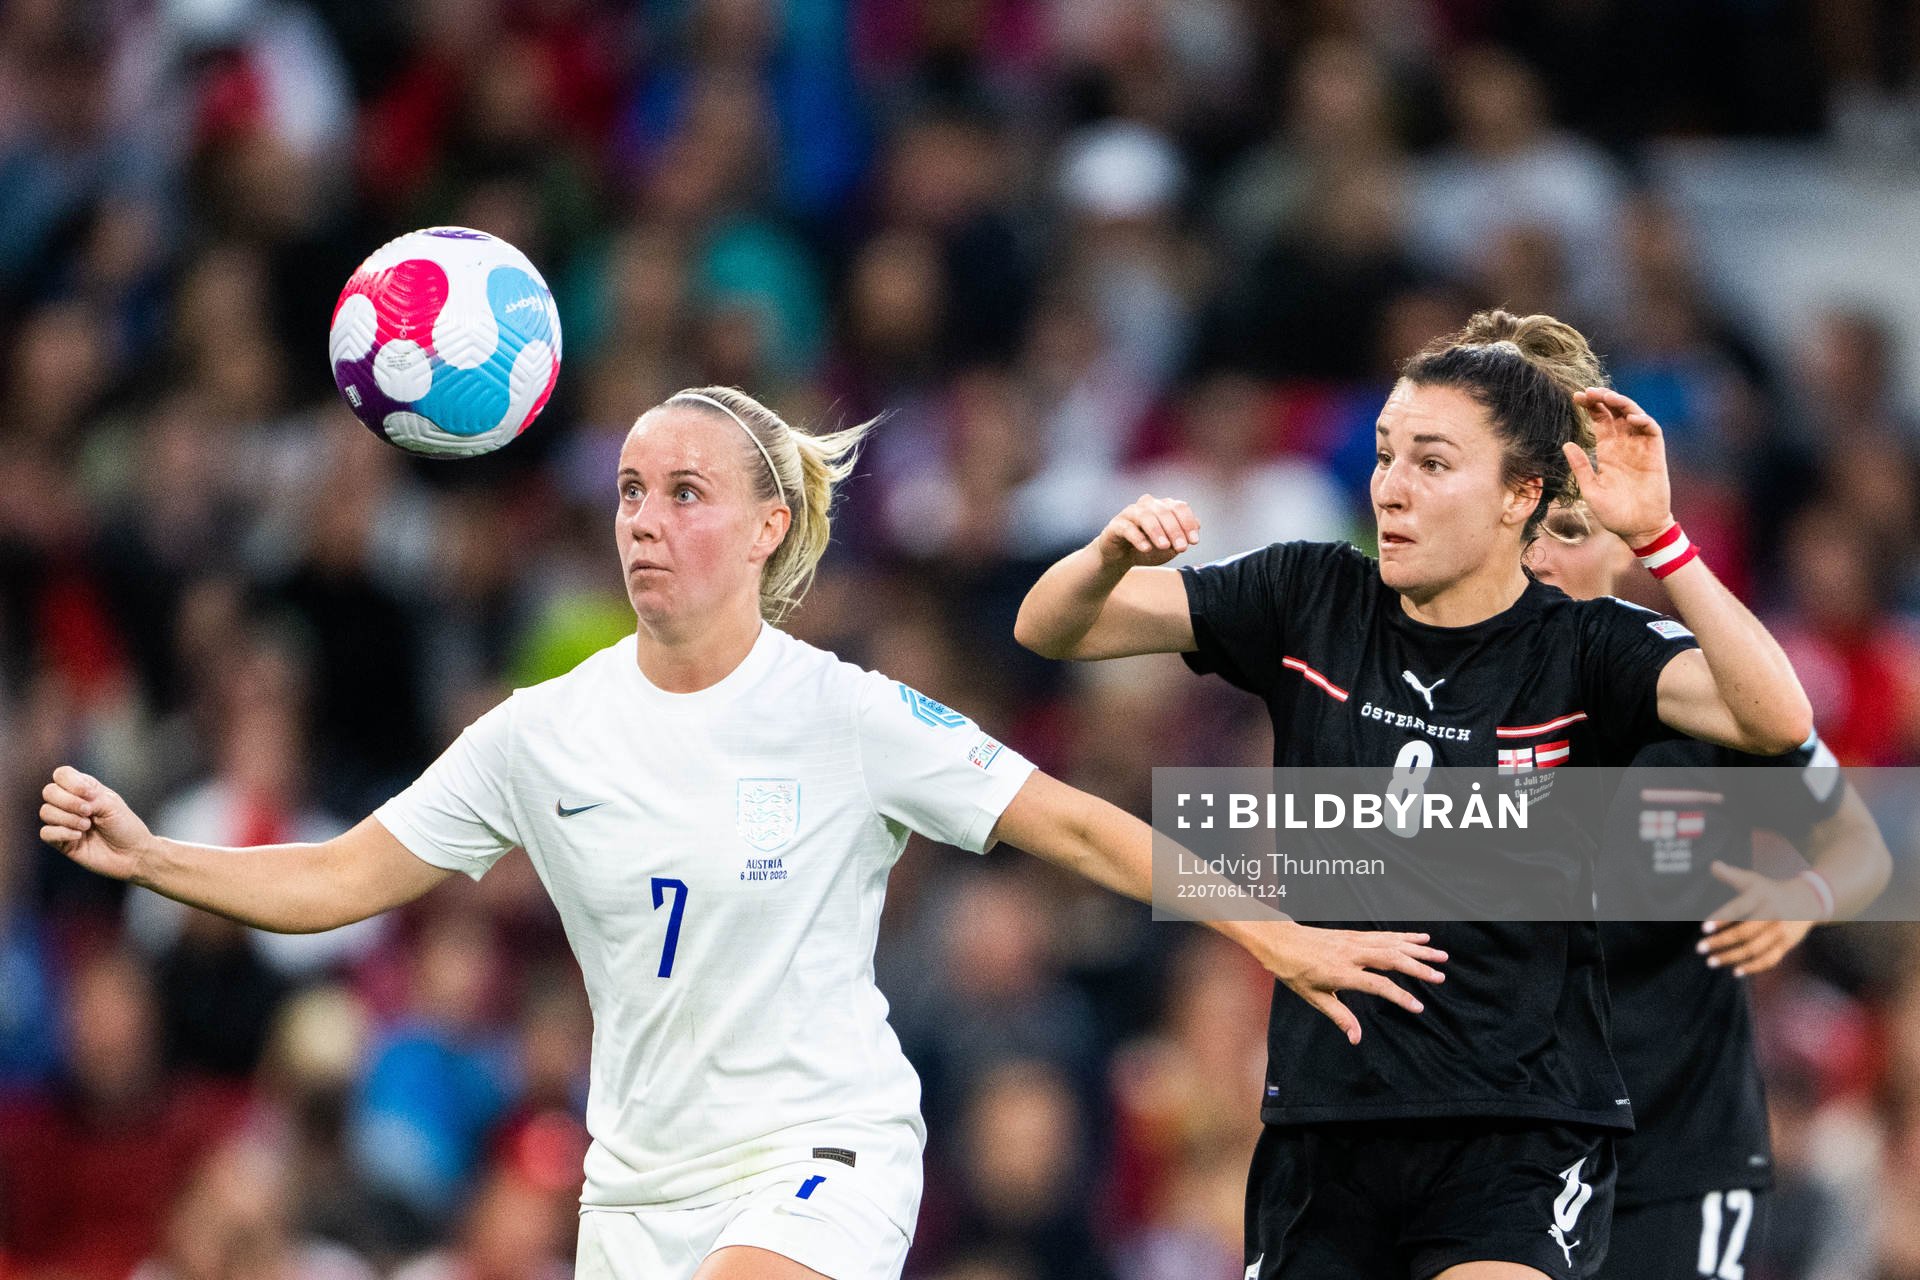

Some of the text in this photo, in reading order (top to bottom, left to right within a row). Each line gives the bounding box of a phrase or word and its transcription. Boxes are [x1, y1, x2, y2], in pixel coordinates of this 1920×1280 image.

[1360, 702, 1471, 741] ÖSTERREICH
[1384, 740, 1433, 838] 8
[1523, 776, 1538, 786] Juli
[740, 870, 788, 881] 6 JULY 2022
[746, 858, 783, 869] AUSTRIA
[651, 877, 688, 978] 7
[1697, 1189, 1753, 1280] 12
